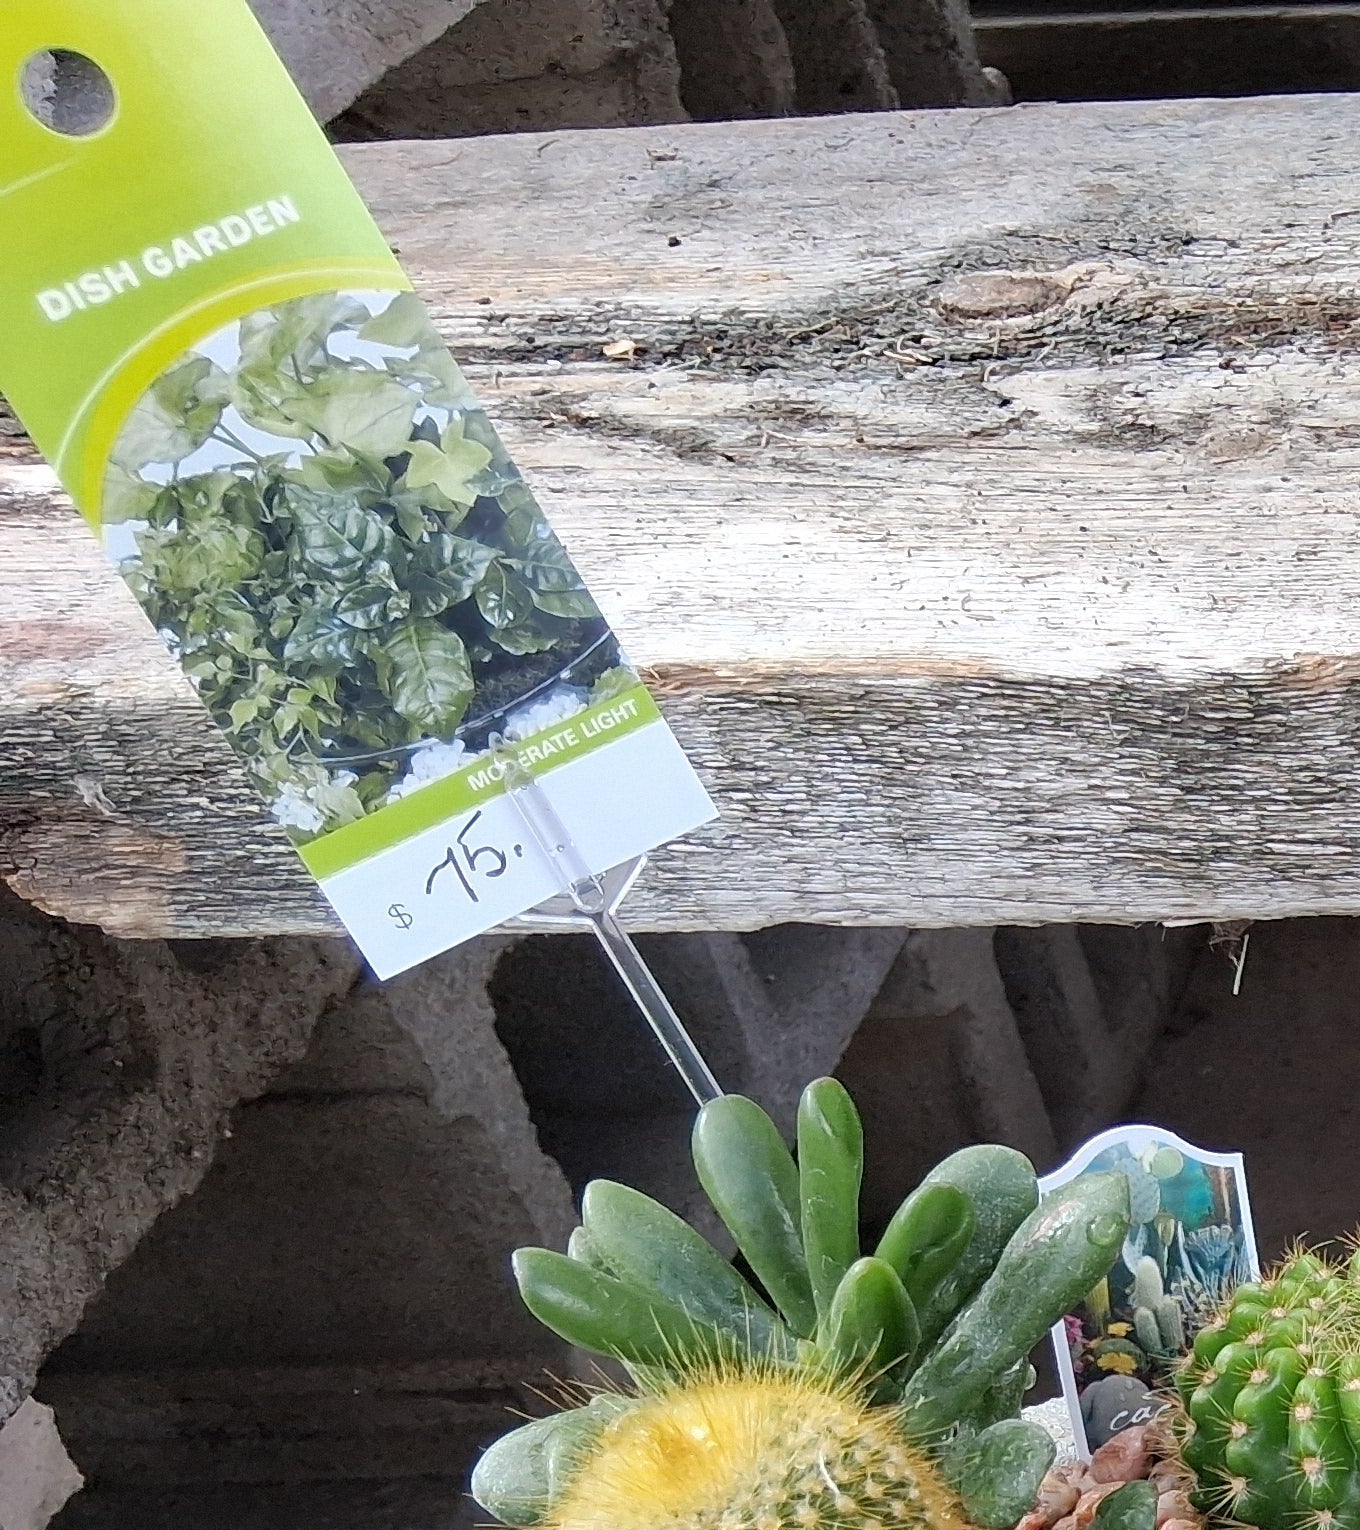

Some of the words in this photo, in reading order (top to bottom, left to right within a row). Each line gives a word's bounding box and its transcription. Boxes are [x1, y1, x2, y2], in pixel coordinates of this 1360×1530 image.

[36, 260, 141, 321] DISH
[142, 195, 300, 278] GARDEN
[467, 727, 580, 792] MOERATE
[580, 699, 638, 738] LIGHT
[388, 904, 413, 930] $
